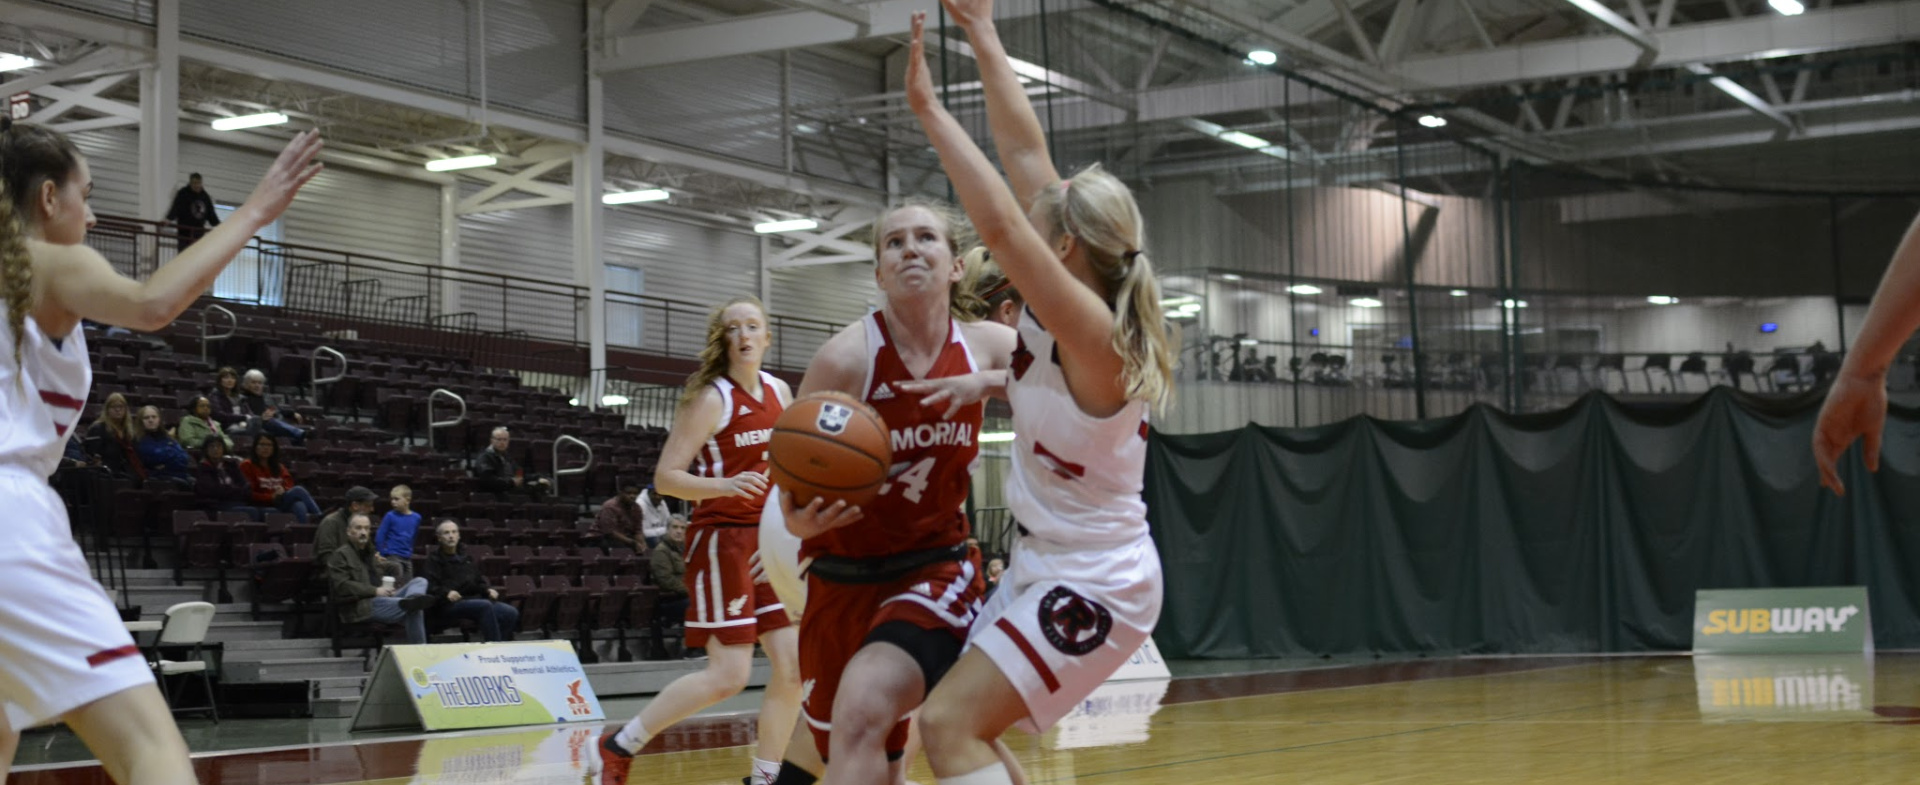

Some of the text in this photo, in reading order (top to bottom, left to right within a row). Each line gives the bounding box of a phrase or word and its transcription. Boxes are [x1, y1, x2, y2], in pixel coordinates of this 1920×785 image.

[1702, 605, 1859, 635] SUBWAY
[478, 653, 546, 664] Proud Supporter of
[511, 666, 544, 675] Memorial
[433, 682, 464, 706] THE
[455, 675, 523, 706] WORKS
